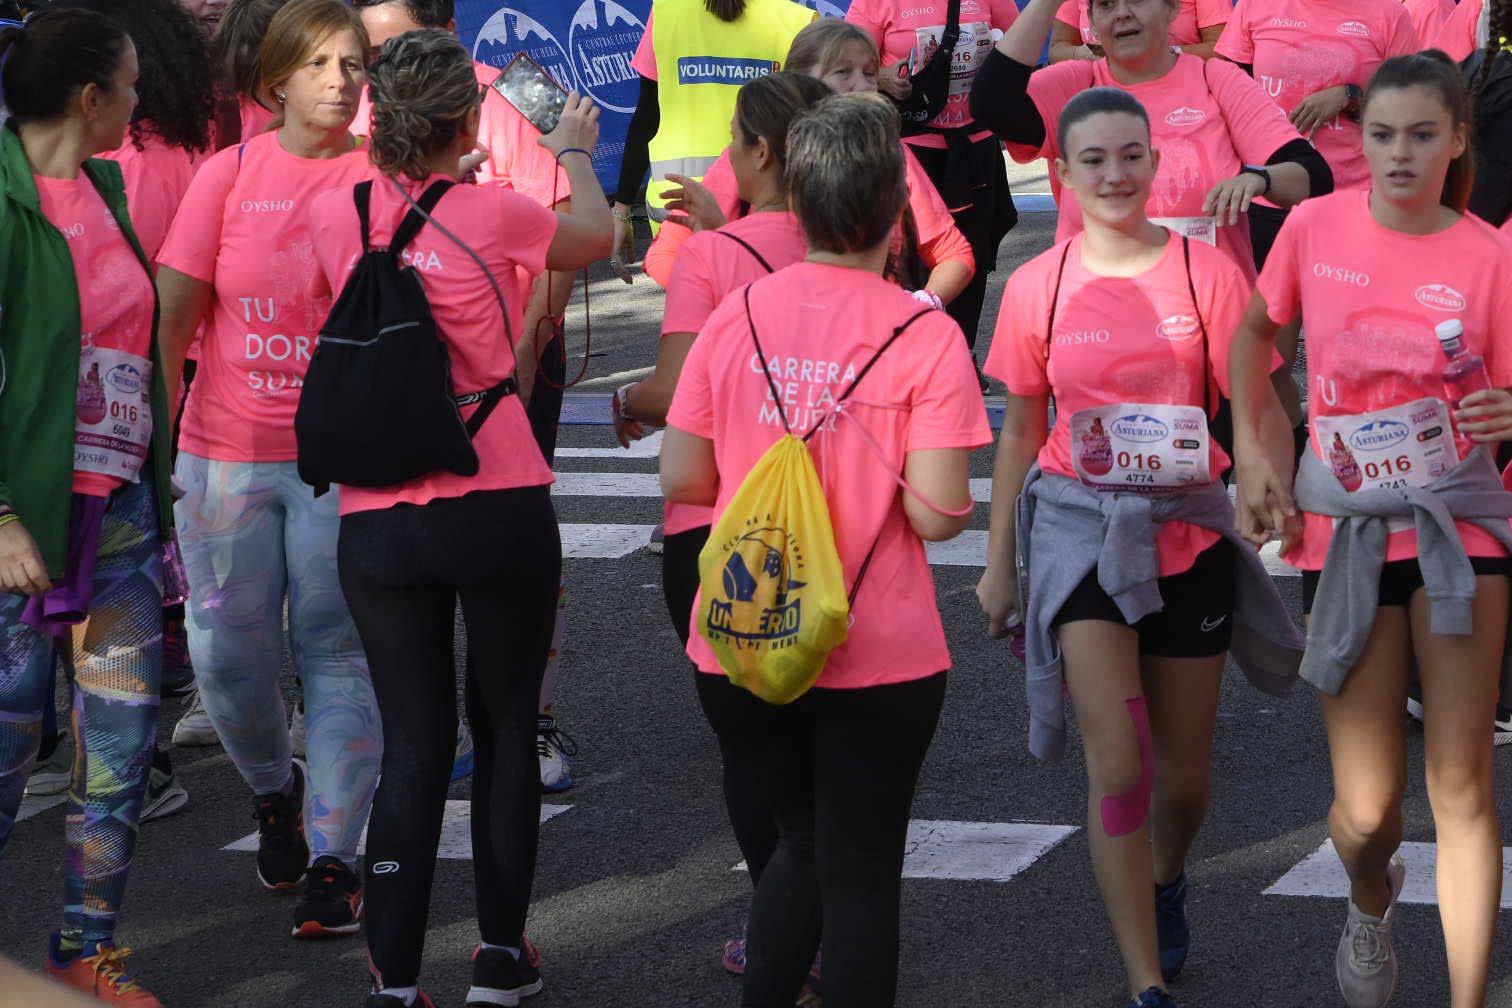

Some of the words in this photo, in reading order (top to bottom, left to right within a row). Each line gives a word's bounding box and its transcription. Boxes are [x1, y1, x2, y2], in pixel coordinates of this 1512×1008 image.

[952, 52, 971, 62] 16
[679, 63, 771, 80] VOLUNTARIS
[1261, 75, 1284, 98] TU
[240, 198, 294, 213] OYSHO
[1313, 263, 1371, 288] OYSHO
[239, 297, 276, 324] TU
[1056, 329, 1110, 345] OYSHO
[750, 353, 857, 384] CARRERA
[768, 380, 800, 405] DE
[806, 384, 834, 408] LA
[110, 400, 138, 422] 016
[757, 404, 839, 433] MUJER
[1115, 422, 1164, 437] ASTURIANA
[1173, 422, 1200, 431] SUMA
[1354, 428, 1406, 448] ASTURIANA
[1117, 451, 1162, 470] 016
[1365, 454, 1412, 479] 016
[1126, 473, 1154, 483] 4774
